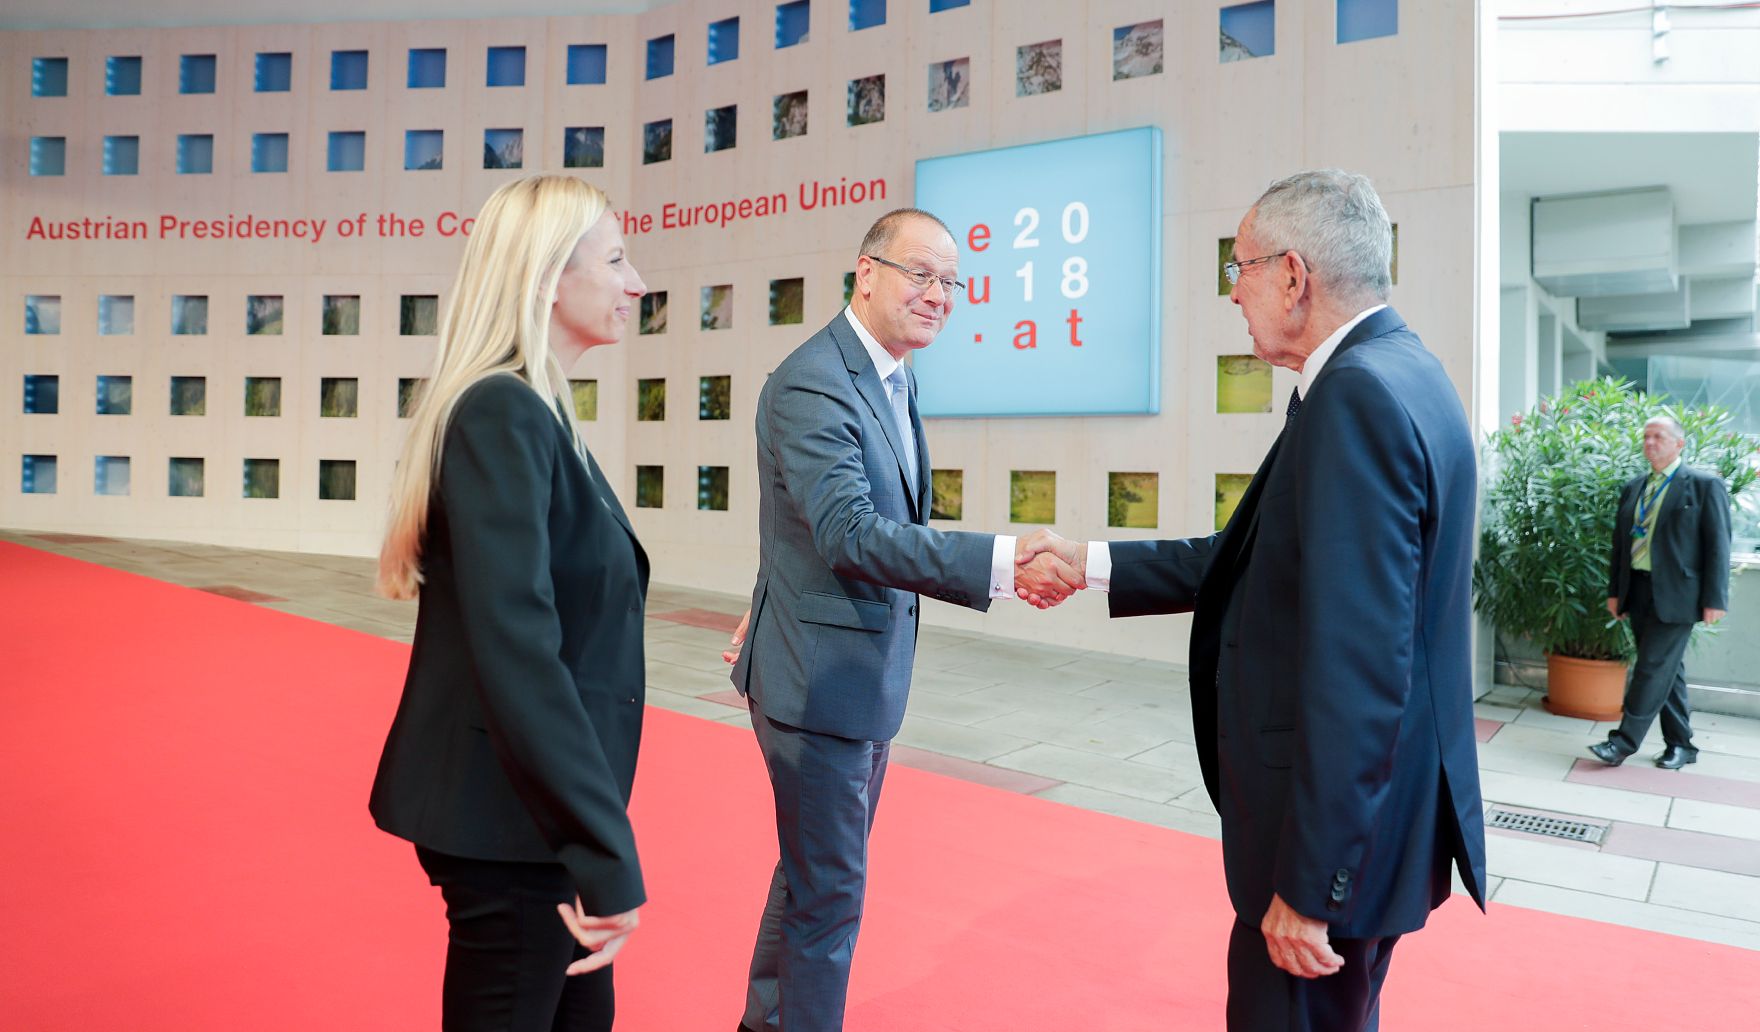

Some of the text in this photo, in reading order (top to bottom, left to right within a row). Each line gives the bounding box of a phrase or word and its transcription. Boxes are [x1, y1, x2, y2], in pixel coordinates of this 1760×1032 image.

[26, 178, 887, 244] Austrian Presidency of the Co he European Union
